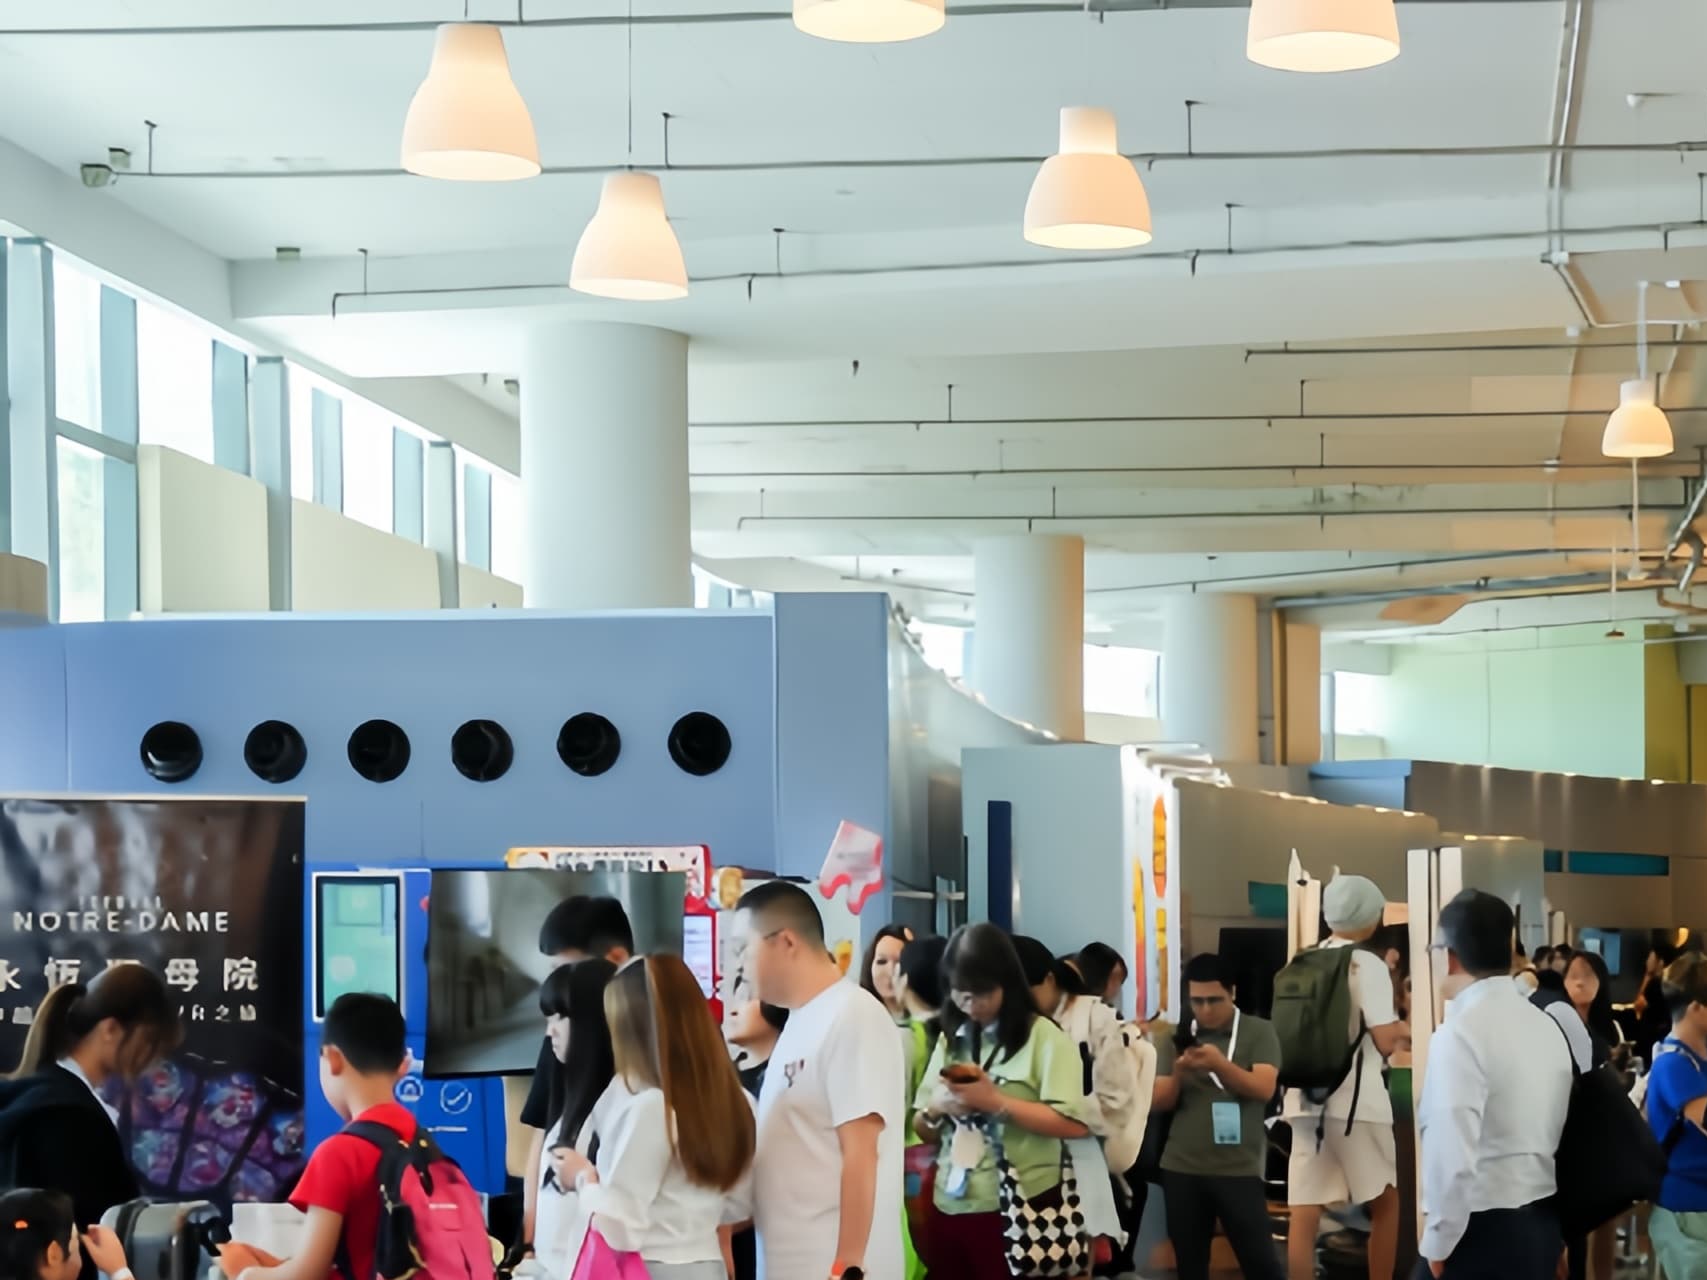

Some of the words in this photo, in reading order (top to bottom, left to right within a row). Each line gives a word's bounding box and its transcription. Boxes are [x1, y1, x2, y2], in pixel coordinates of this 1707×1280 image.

[13, 911, 229, 933] NOTRE-DAME
[0, 956, 259, 992] 永恆母院
